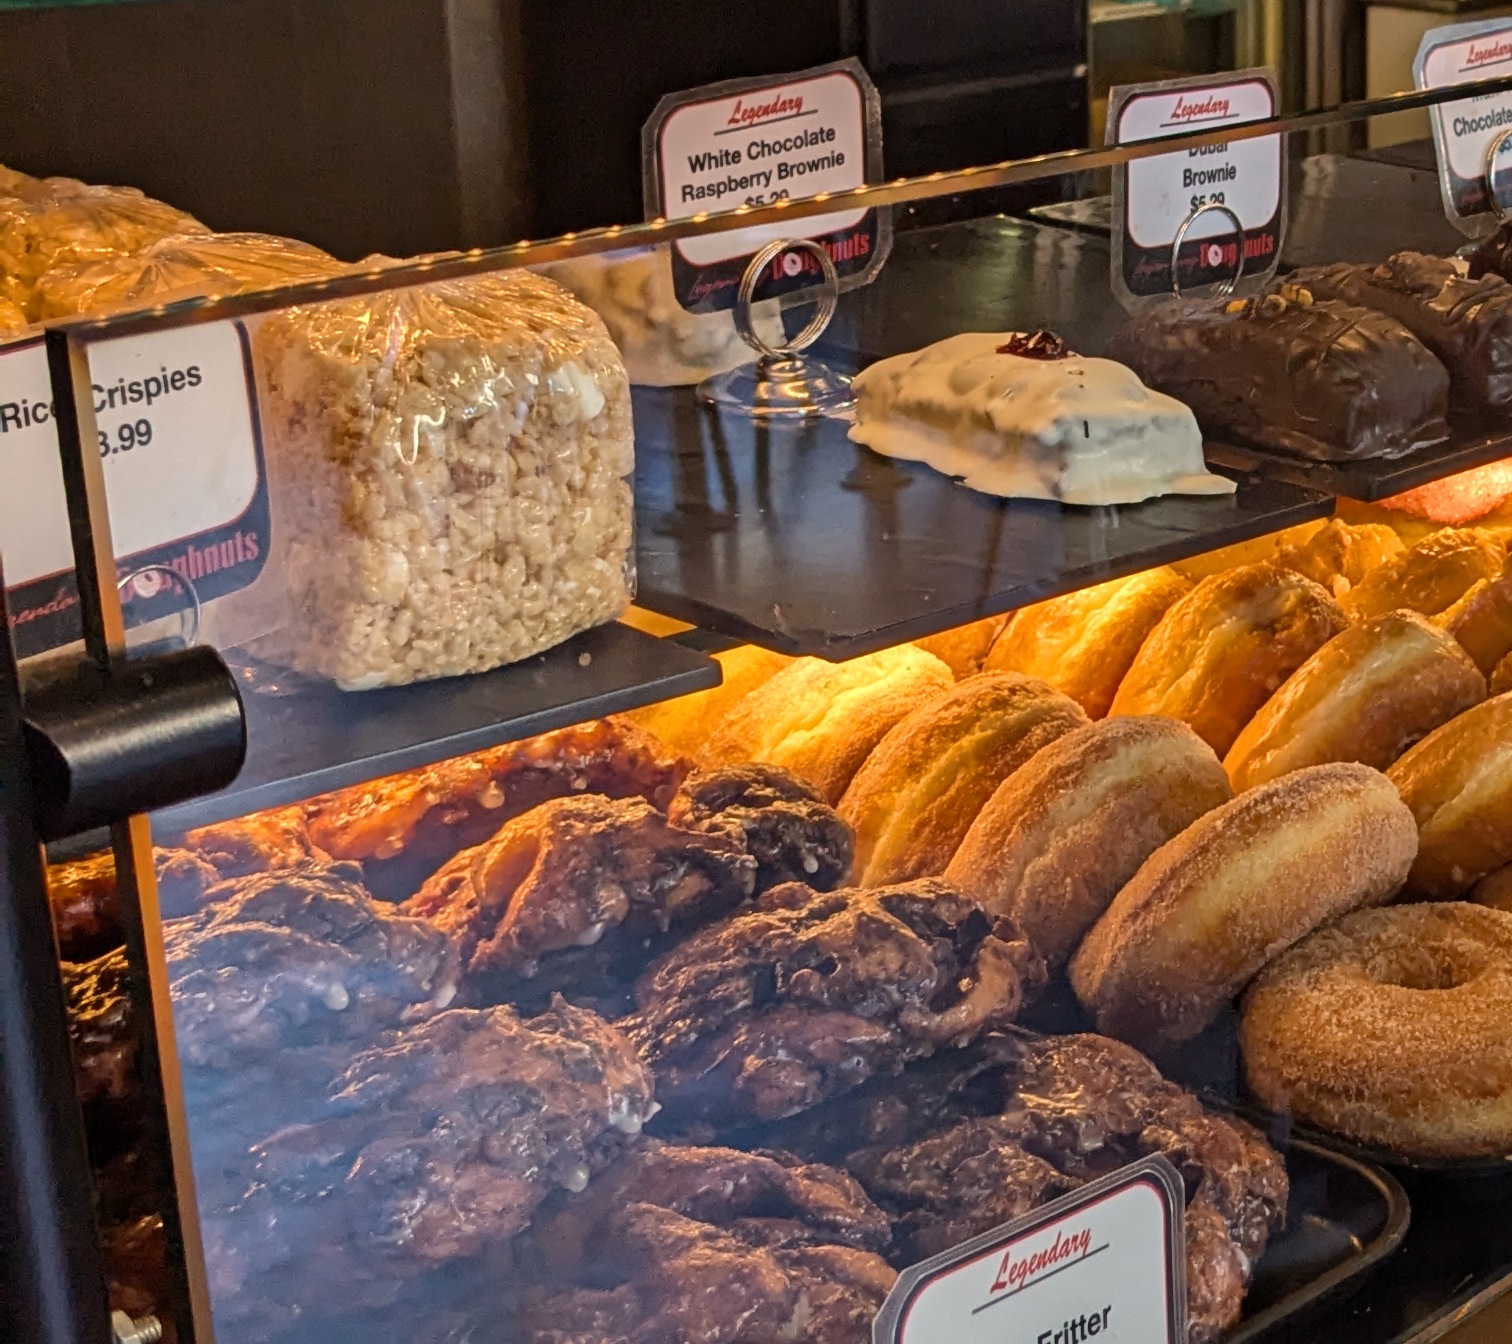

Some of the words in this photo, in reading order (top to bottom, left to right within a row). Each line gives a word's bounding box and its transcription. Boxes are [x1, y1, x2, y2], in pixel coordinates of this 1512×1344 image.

[728, 93, 804, 126] Legendary
[1170, 94, 1231, 121] Legendary
[687, 147, 742, 174] White
[746, 126, 837, 162] Chocolate
[681, 168, 773, 203] Raspberry
[777, 149, 846, 181] Brownie
[1182, 162, 1237, 188] Brownie
[1190, 191, 1226, 212] $529
[92, 364, 203, 414] Crispies
[98, 418, 153, 459] 3.99
[989, 1224, 1093, 1295] Legendary
